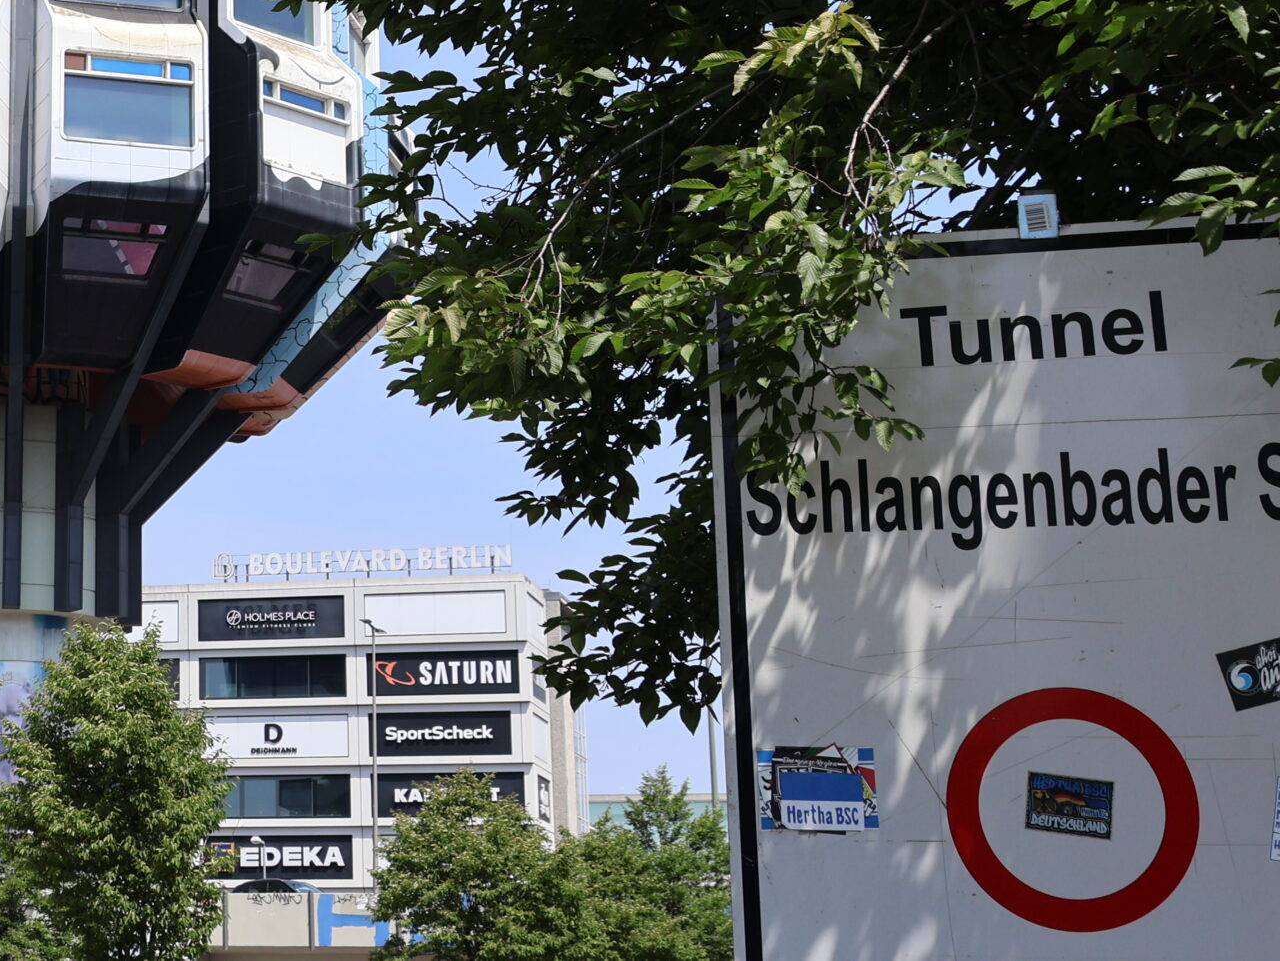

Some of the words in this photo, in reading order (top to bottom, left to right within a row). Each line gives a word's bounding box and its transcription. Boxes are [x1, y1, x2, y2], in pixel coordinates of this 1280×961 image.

[900, 290, 1167, 367] Tunnel
[746, 448, 1237, 551] Schlangenbader
[248, 548, 407, 576] BOULEVARD
[419, 544, 512, 570] BERLIN
[244, 612, 284, 622] HOLMES
[285, 611, 315, 620] PLACE
[419, 660, 512, 685] SATURN
[385, 724, 493, 743] SportScheck
[250, 747, 297, 755] DEICHMANN
[787, 805, 832, 825] Hertha
[835, 807, 859, 825] BSC
[1030, 813, 1108, 834] DEUTSCHLAND
[240, 846, 345, 867] EDEKA
